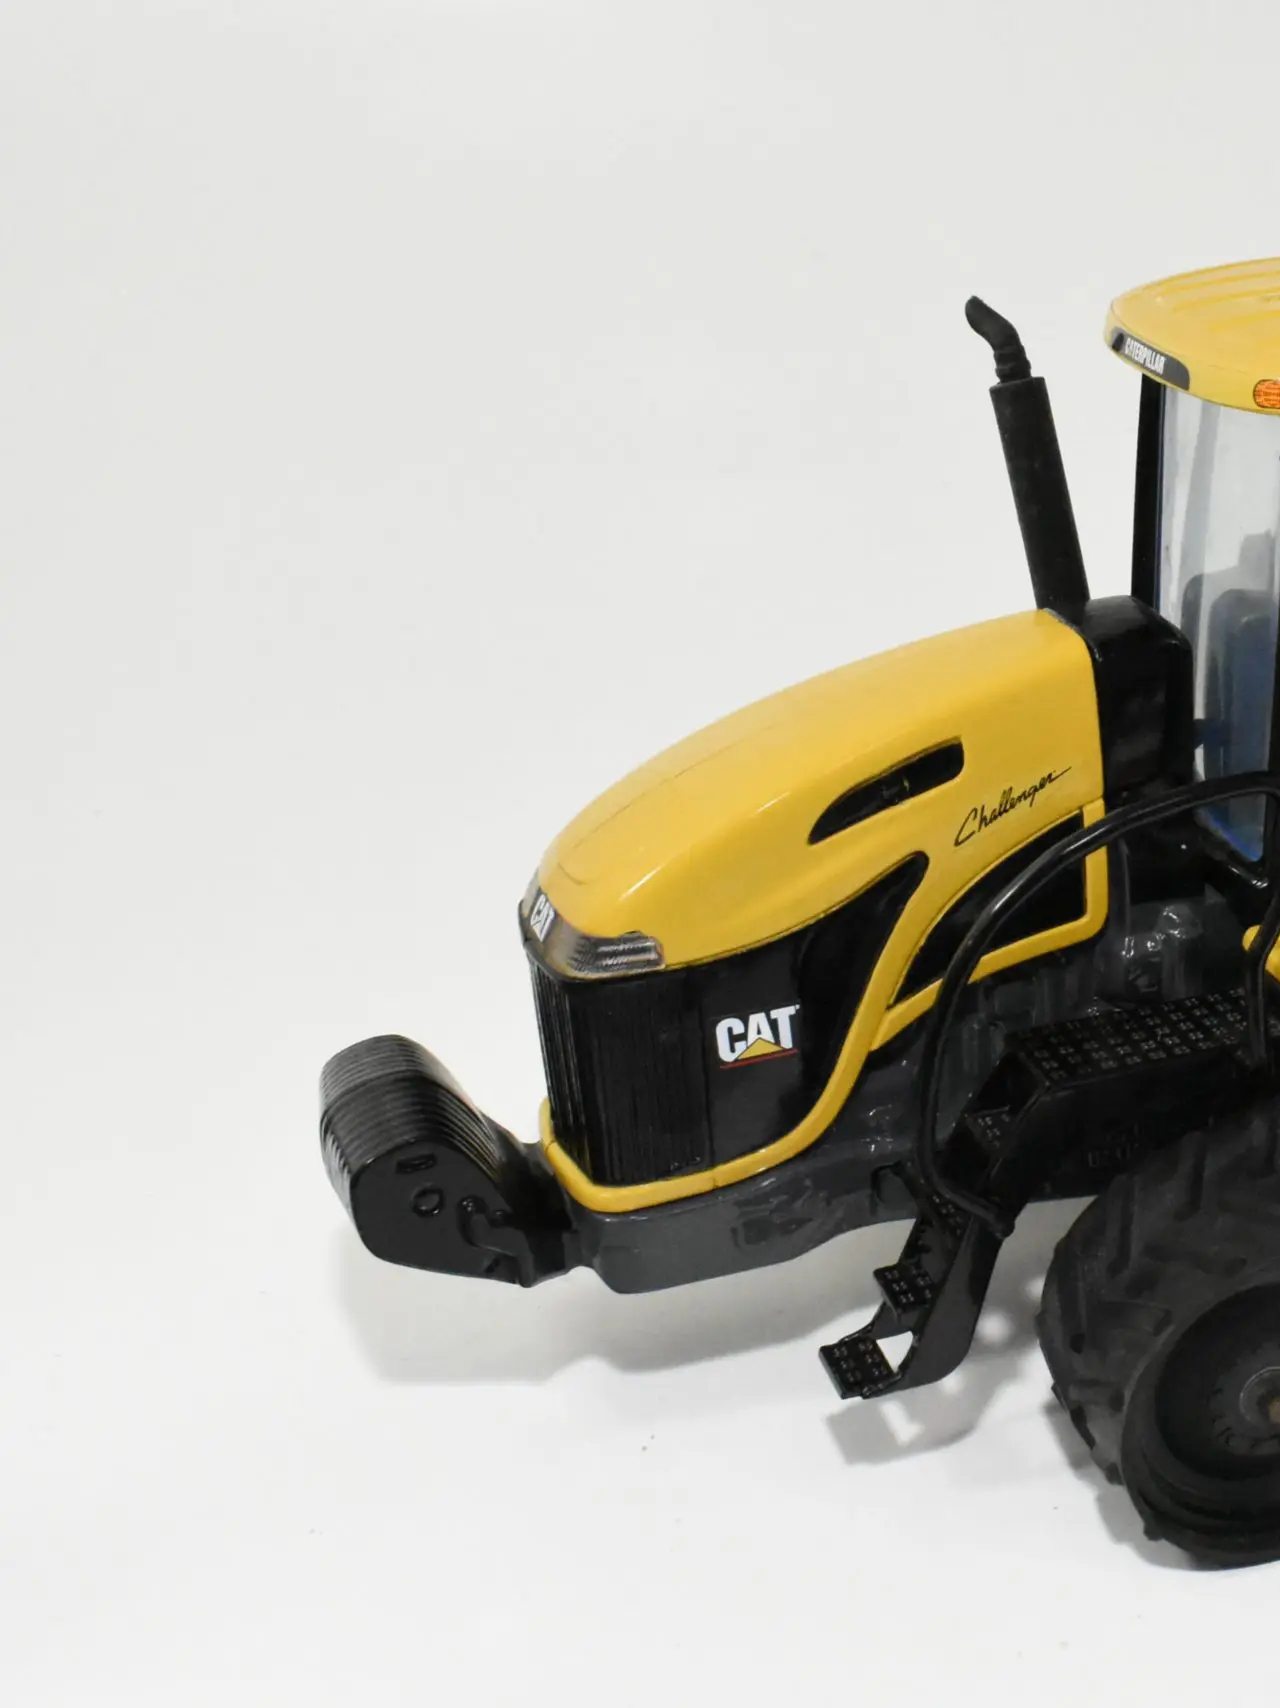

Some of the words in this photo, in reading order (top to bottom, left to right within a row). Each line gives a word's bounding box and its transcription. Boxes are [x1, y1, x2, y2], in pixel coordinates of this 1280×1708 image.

[1125, 337, 1166, 376] CATERPILLAR
[953, 765, 1073, 847] Challenger
[529, 893, 555, 943] CAT
[715, 1004, 797, 1063] CAT
